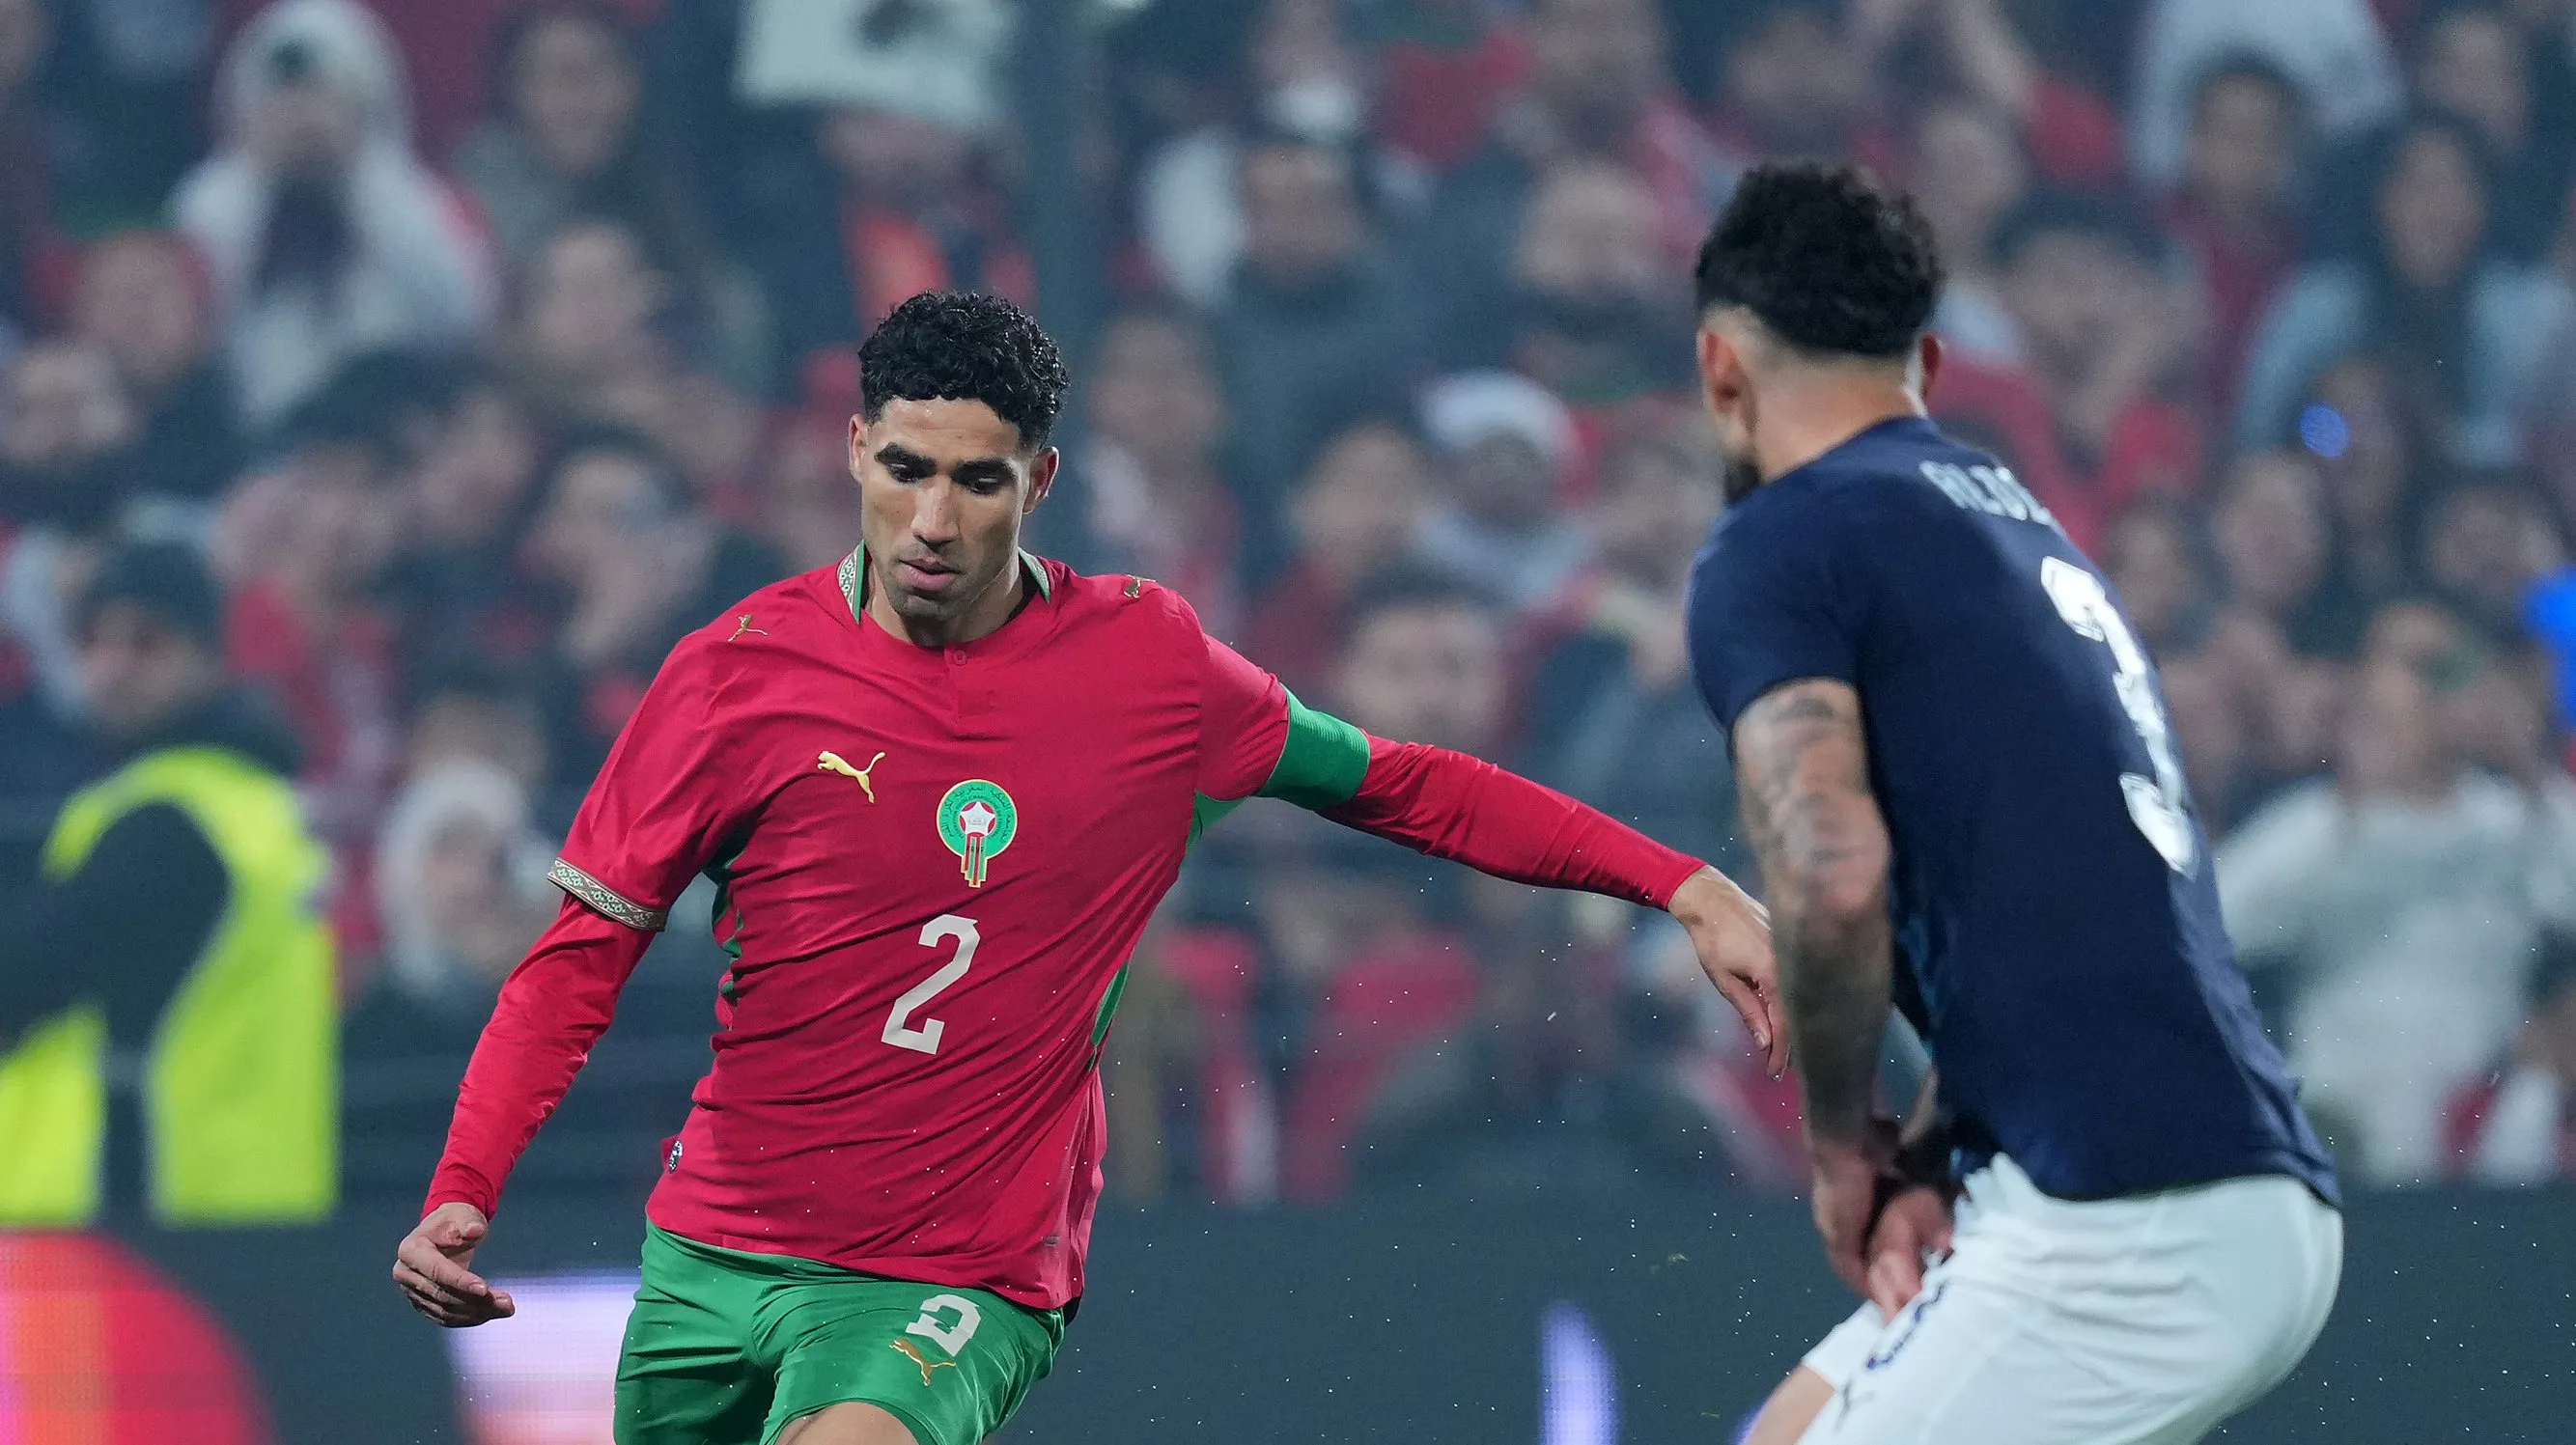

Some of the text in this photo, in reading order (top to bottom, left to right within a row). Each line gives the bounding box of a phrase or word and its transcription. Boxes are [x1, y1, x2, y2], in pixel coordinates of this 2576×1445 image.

[2040, 555, 2199, 880] 3
[881, 913, 981, 1055] 2
[905, 1293, 982, 1357] 2
